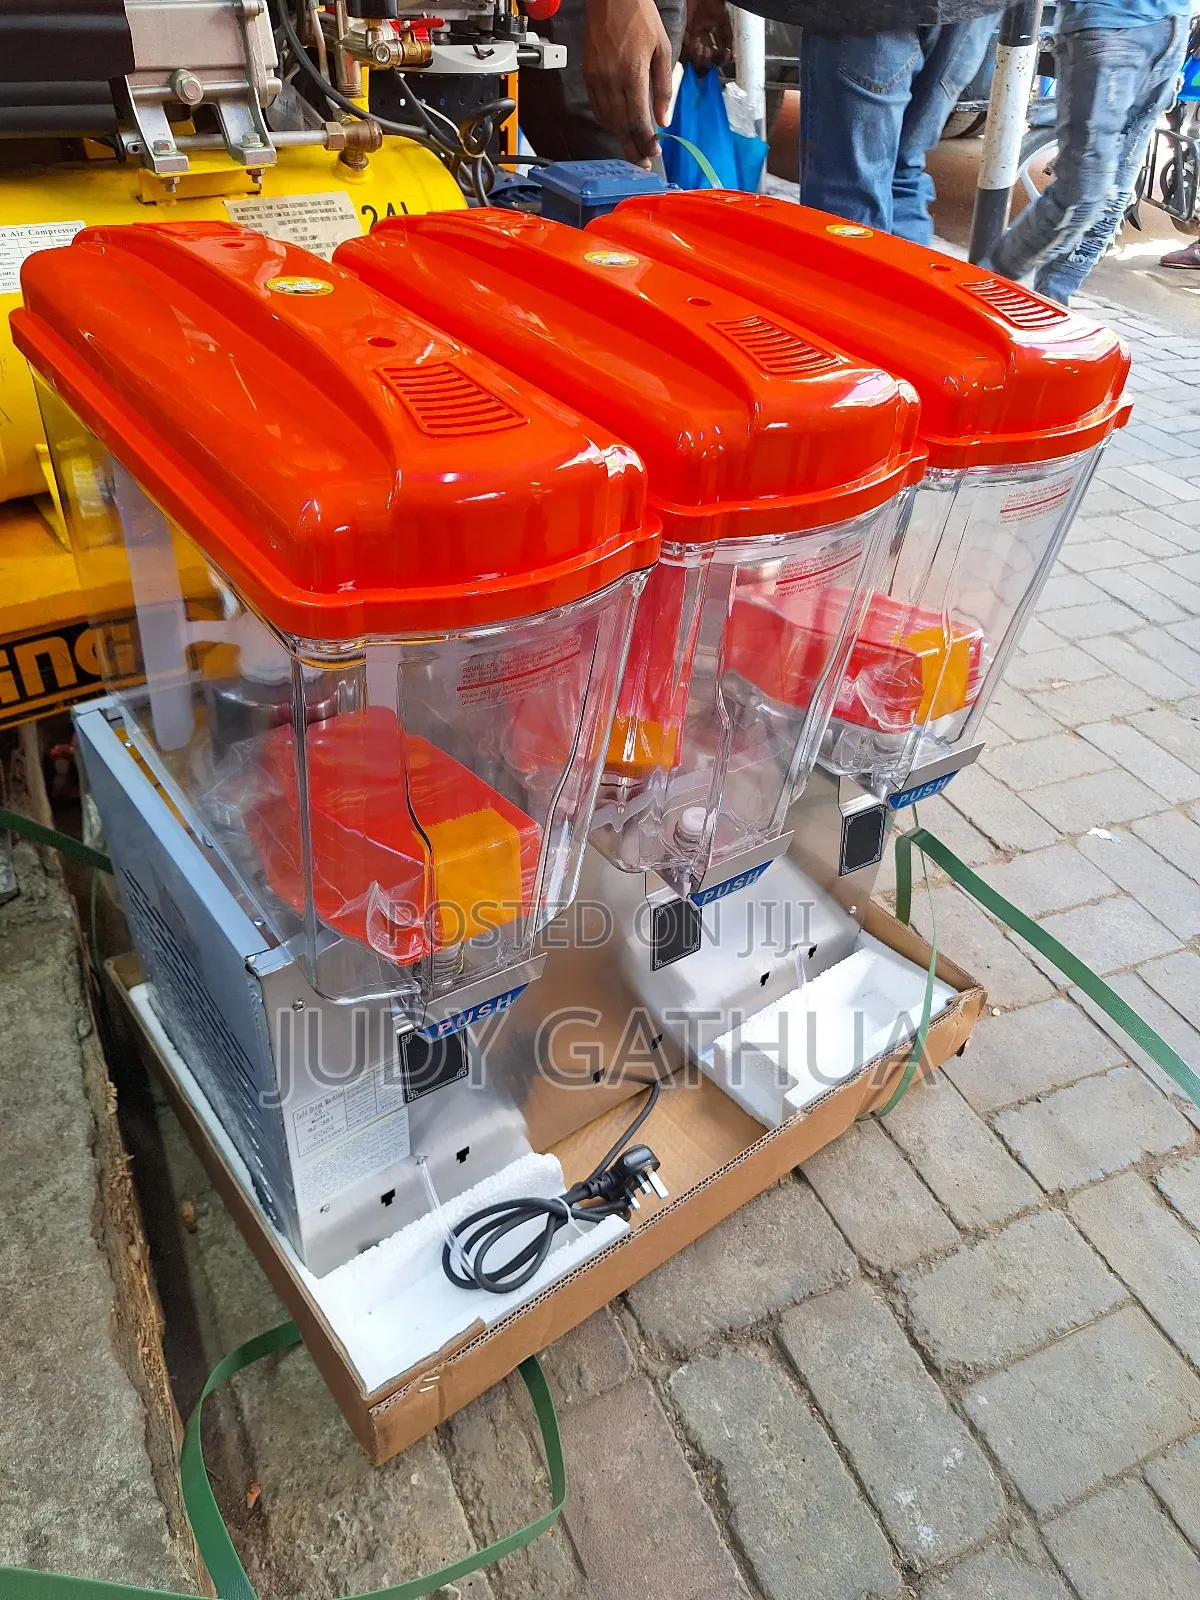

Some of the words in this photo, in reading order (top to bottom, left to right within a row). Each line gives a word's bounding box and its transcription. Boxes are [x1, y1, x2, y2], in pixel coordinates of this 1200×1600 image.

[28, 226, 78, 236] Compressor
[897, 777, 948, 807] PUSH
[702, 870, 760, 904] PUSH
[437, 994, 512, 1036] PUSH
[296, 1108, 308, 1120] Cold
[309, 1101, 323, 1114] Drink
